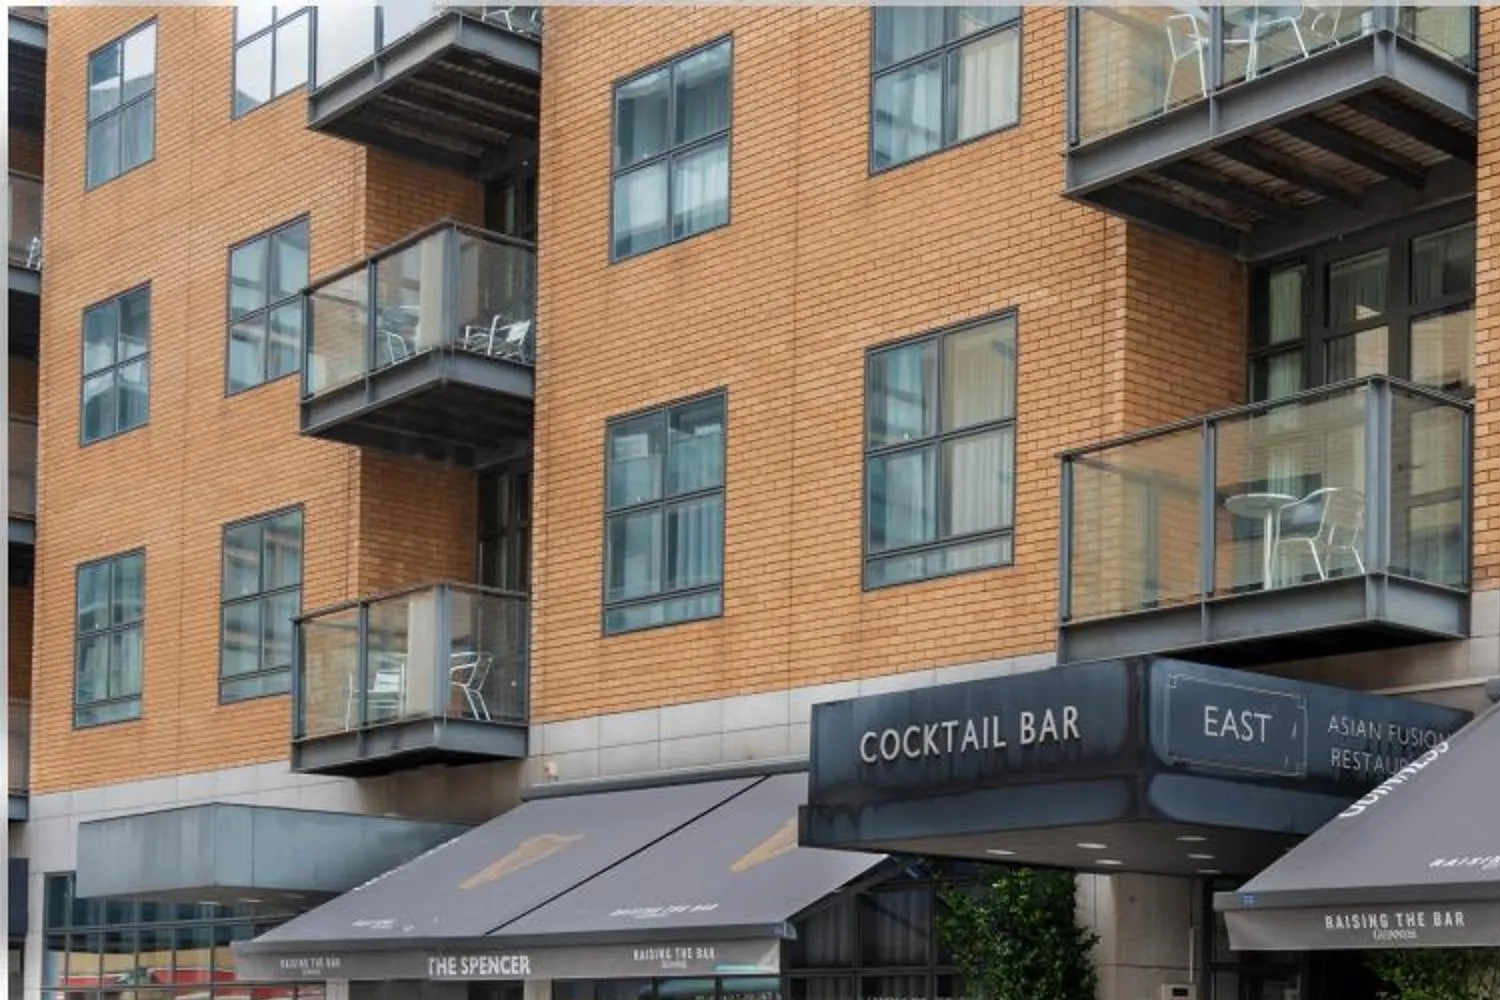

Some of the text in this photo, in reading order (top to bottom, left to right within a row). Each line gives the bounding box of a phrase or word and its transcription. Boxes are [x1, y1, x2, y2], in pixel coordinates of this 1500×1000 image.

[860, 705, 1081, 763] COCKTAIL BAR
[1204, 706, 1273, 743] EAST
[1327, 715, 1382, 741] ASIAN
[1325, 911, 1465, 929] RAISING THE BAR
[428, 955, 531, 976] THE SPENCER
